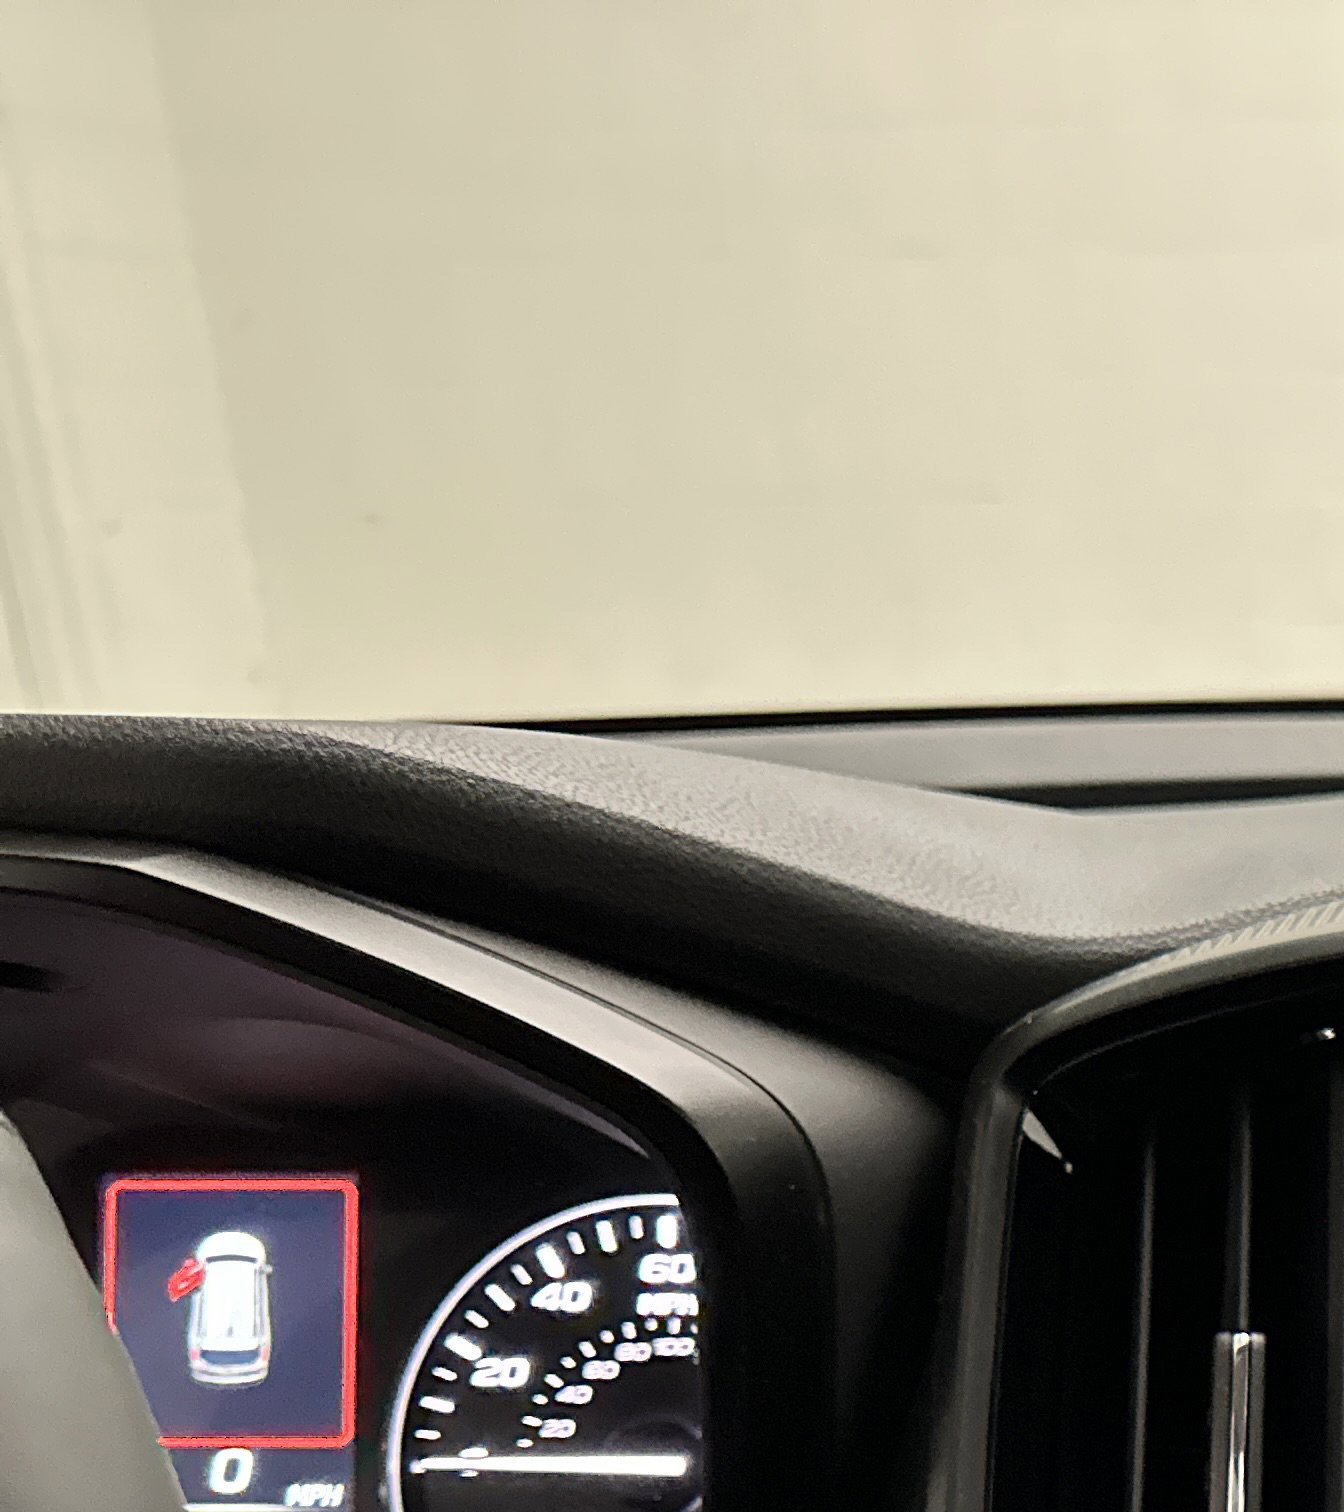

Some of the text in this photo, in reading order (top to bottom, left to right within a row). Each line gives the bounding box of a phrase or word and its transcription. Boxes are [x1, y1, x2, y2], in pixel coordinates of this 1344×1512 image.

[638, 1253, 697, 1284] 60
[530, 1281, 593, 1313] 40
[469, 1357, 531, 1388] 20
[208, 1448, 254, 1494] 0
[285, 1483, 344, 1507] MPH
